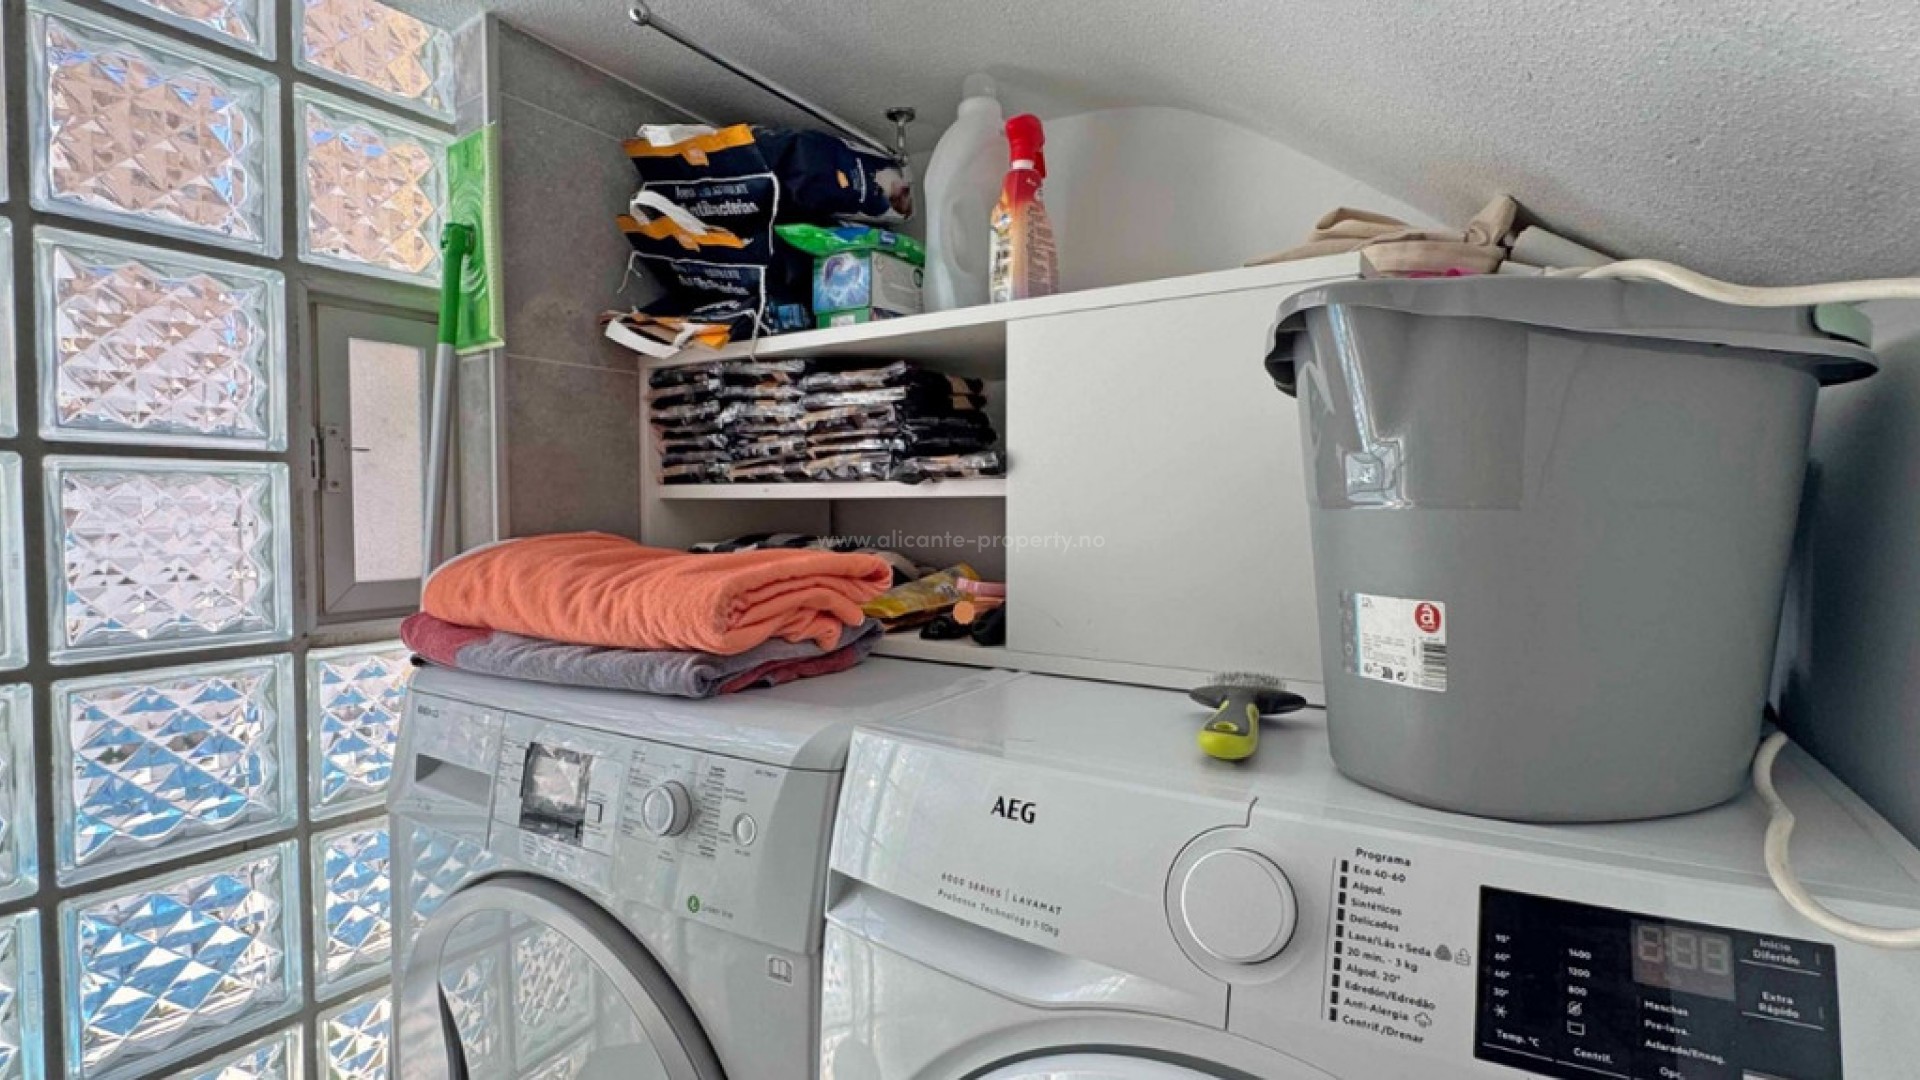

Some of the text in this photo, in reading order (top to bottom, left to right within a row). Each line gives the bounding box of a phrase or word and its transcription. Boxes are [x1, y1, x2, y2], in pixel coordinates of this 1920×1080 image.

[990, 795, 1036, 824] AEG
[1356, 847, 1411, 866] Programa
[1354, 864, 1406, 883] Eco 40-60
[968, 880, 1001, 898] SERIES
[1012, 893, 1062, 915] LAVAMAT
[1351, 897, 1402, 916] Sintéticos
[981, 903, 1031, 927] Technology
[1349, 913, 1399, 932] Delicados
[1568, 948, 1592, 960] 1400
[1753, 950, 1800, 966] Diferido
[1404, 960, 1418, 973] kg
[1568, 966, 1591, 978] 1200
[1762, 991, 1794, 1006] Extra
[1343, 998, 1409, 1020] Anti-Alergia
[1644, 1000, 1689, 1017] Manchas
[1758, 1002, 1800, 1019] Rápido
[1496, 1028, 1526, 1044] Temp.
